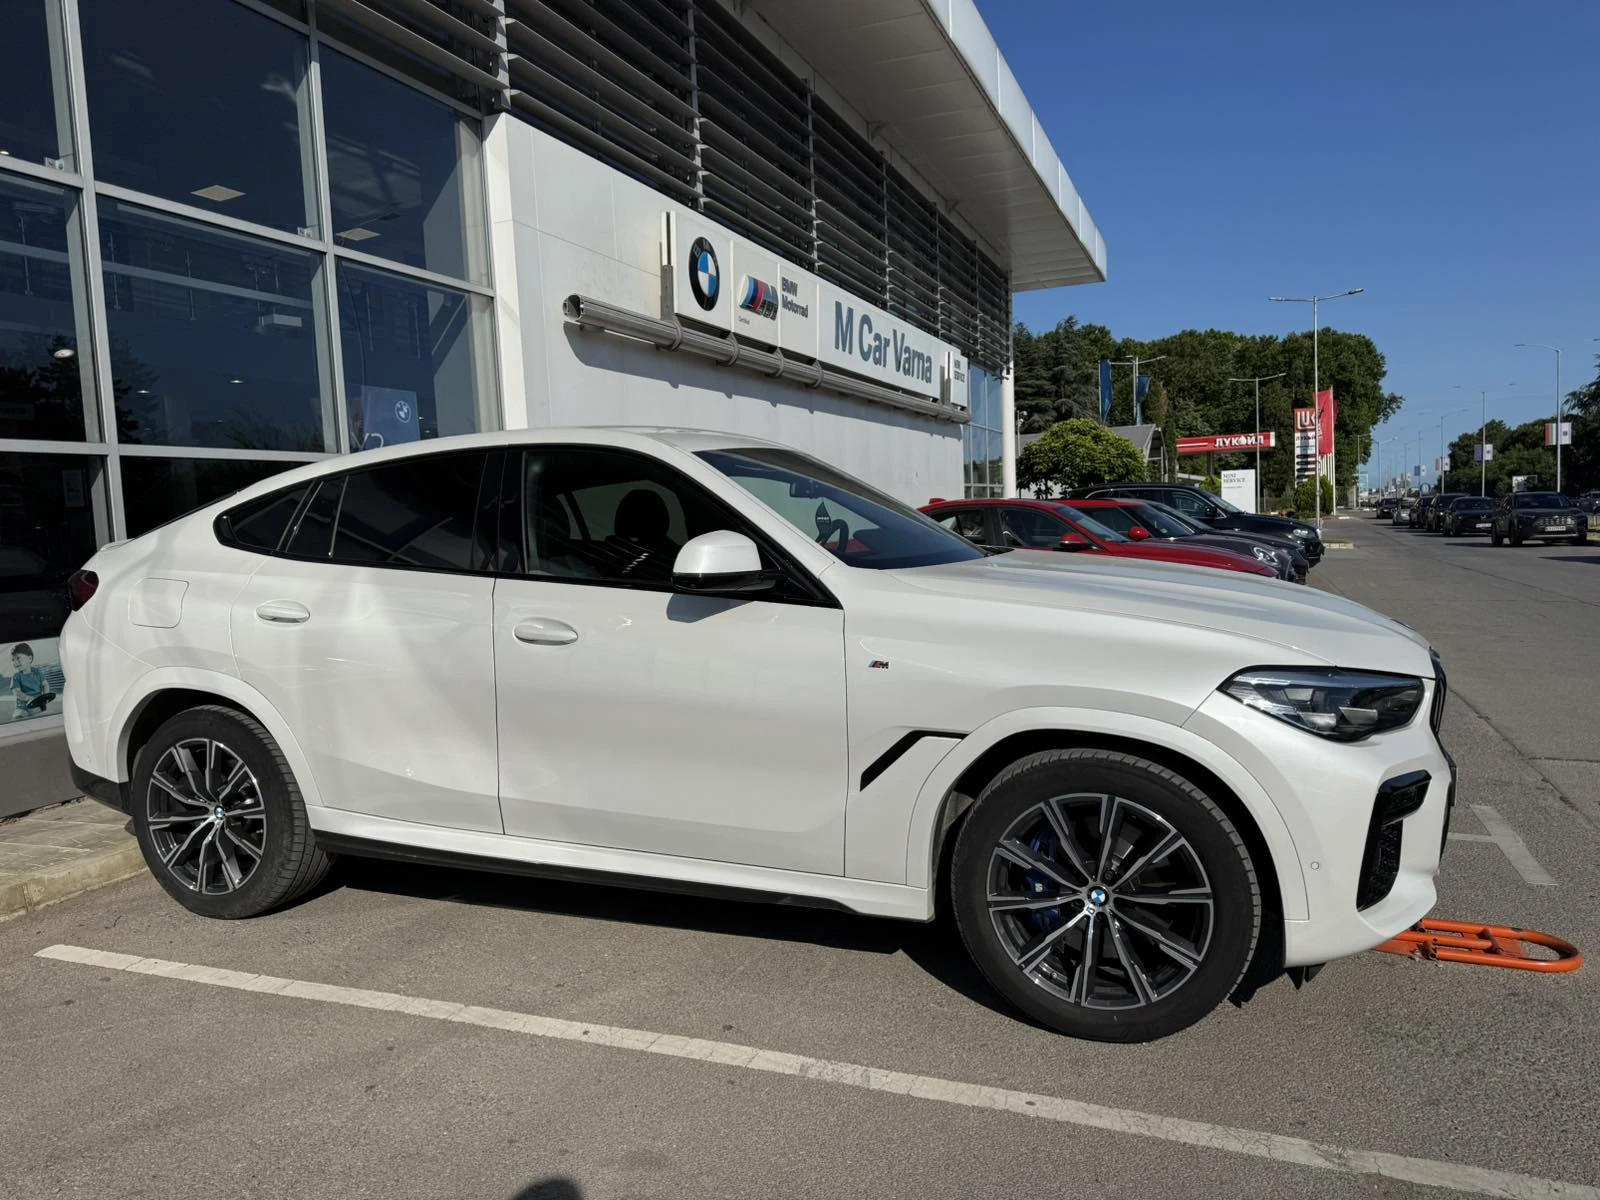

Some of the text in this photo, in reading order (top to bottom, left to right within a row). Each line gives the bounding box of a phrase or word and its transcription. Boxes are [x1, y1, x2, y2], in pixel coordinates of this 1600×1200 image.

[782, 277, 798, 297] BMW
[782, 294, 809, 318] Motorrad
[835, 301, 933, 384] M Car Varna
[1215, 433, 1264, 447] ЛУКОЙЛ
